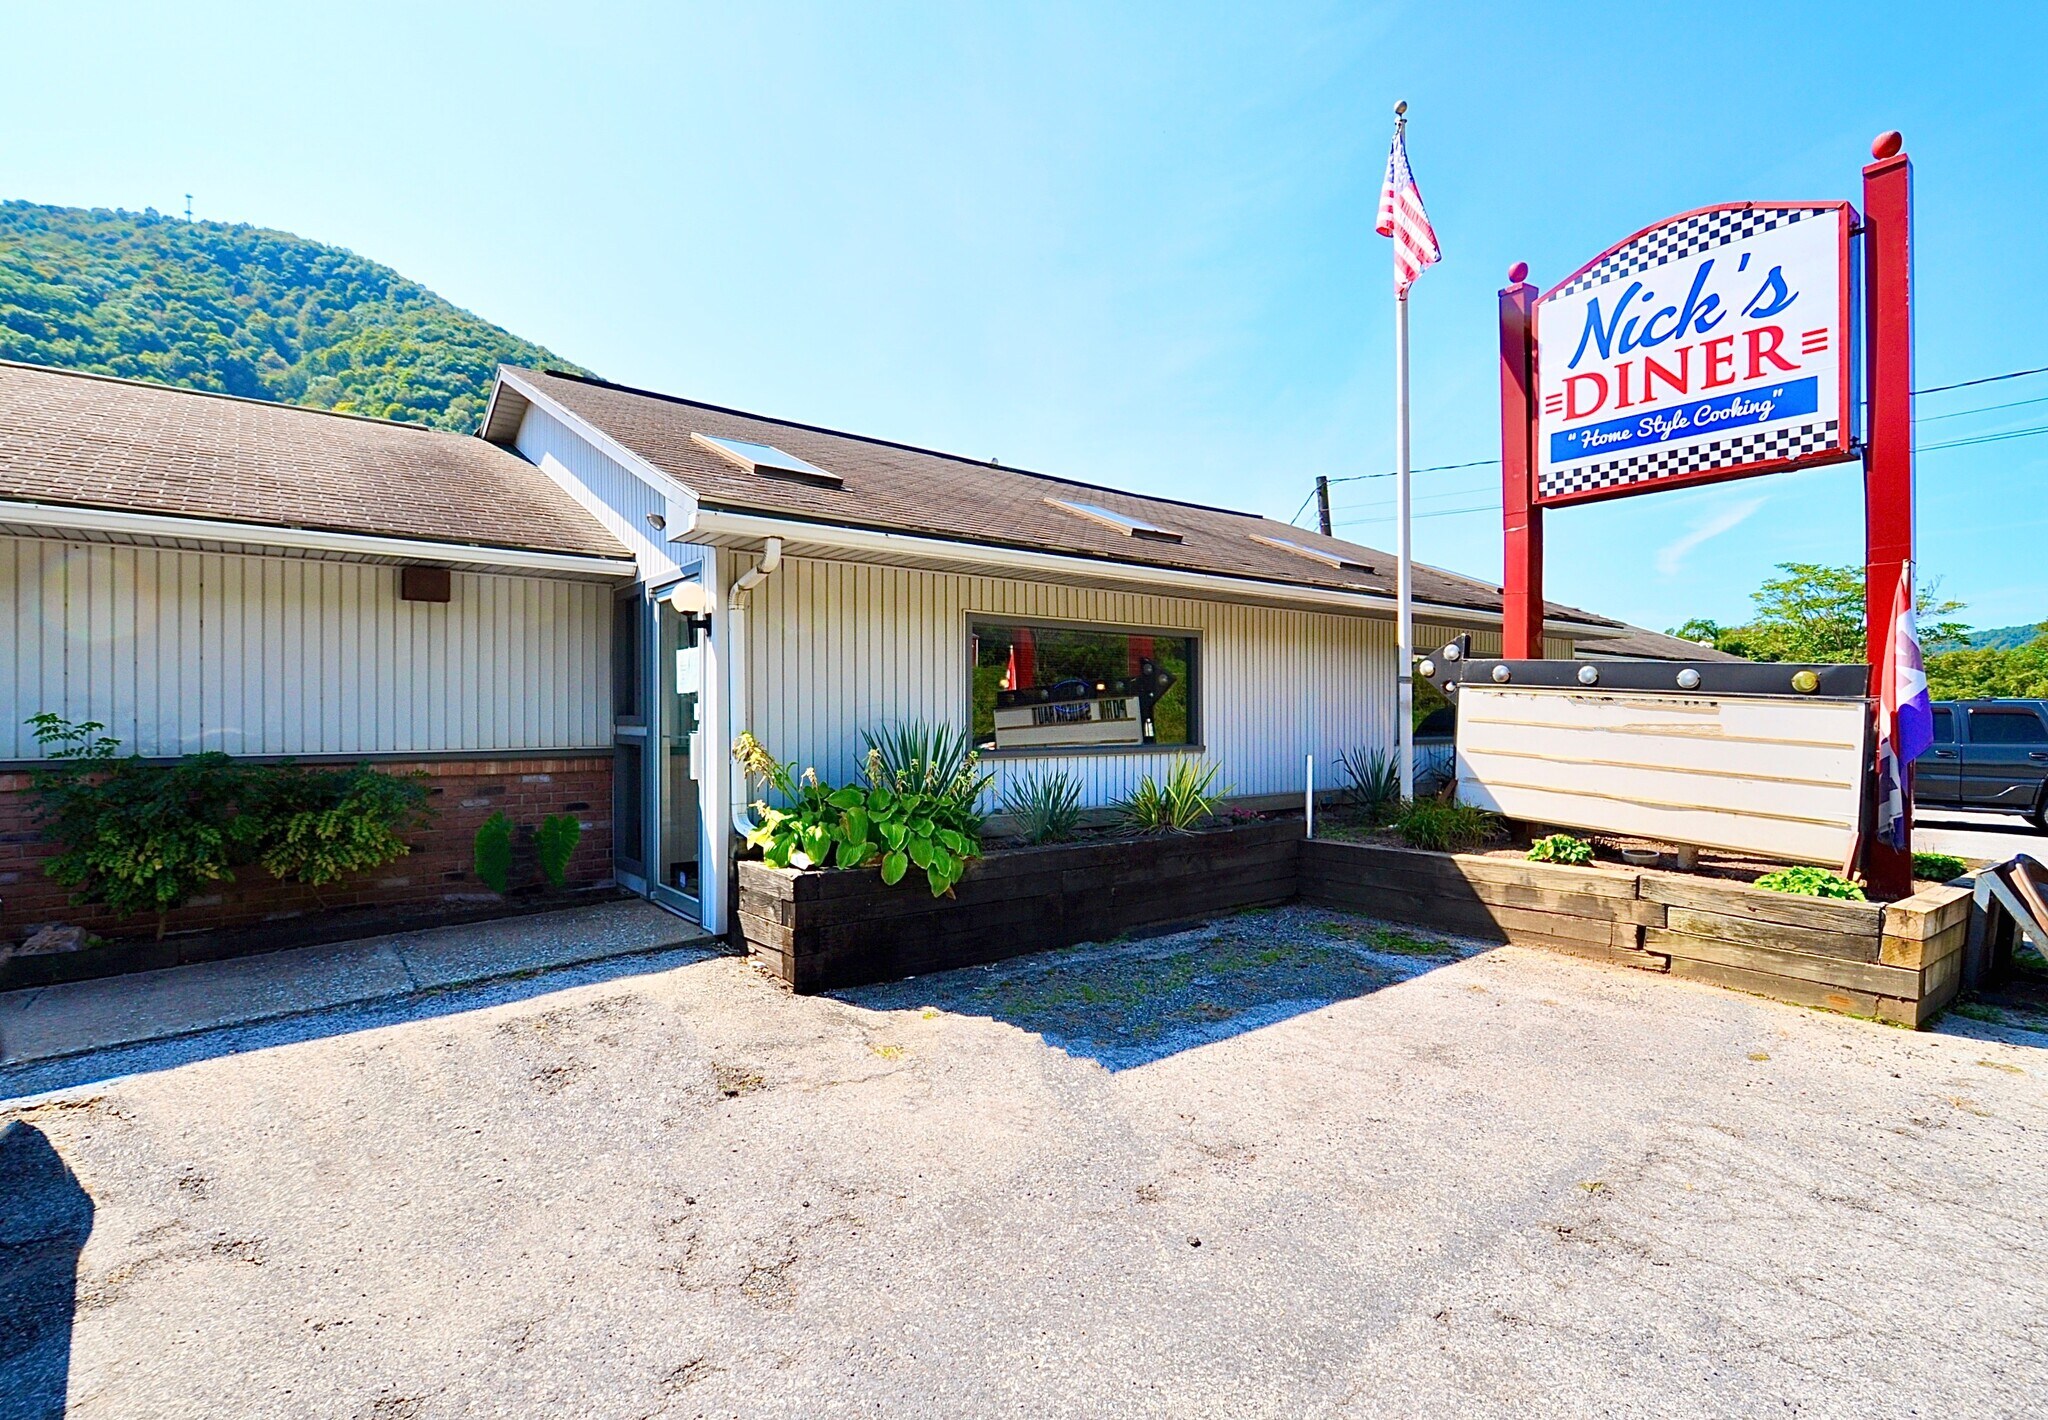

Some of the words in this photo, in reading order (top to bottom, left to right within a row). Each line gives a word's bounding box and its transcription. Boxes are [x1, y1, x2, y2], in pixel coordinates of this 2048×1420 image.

[1567, 252, 1799, 370] Nick's
[1562, 325, 1801, 421] DINER
[1636, 409, 1691, 441] Style
